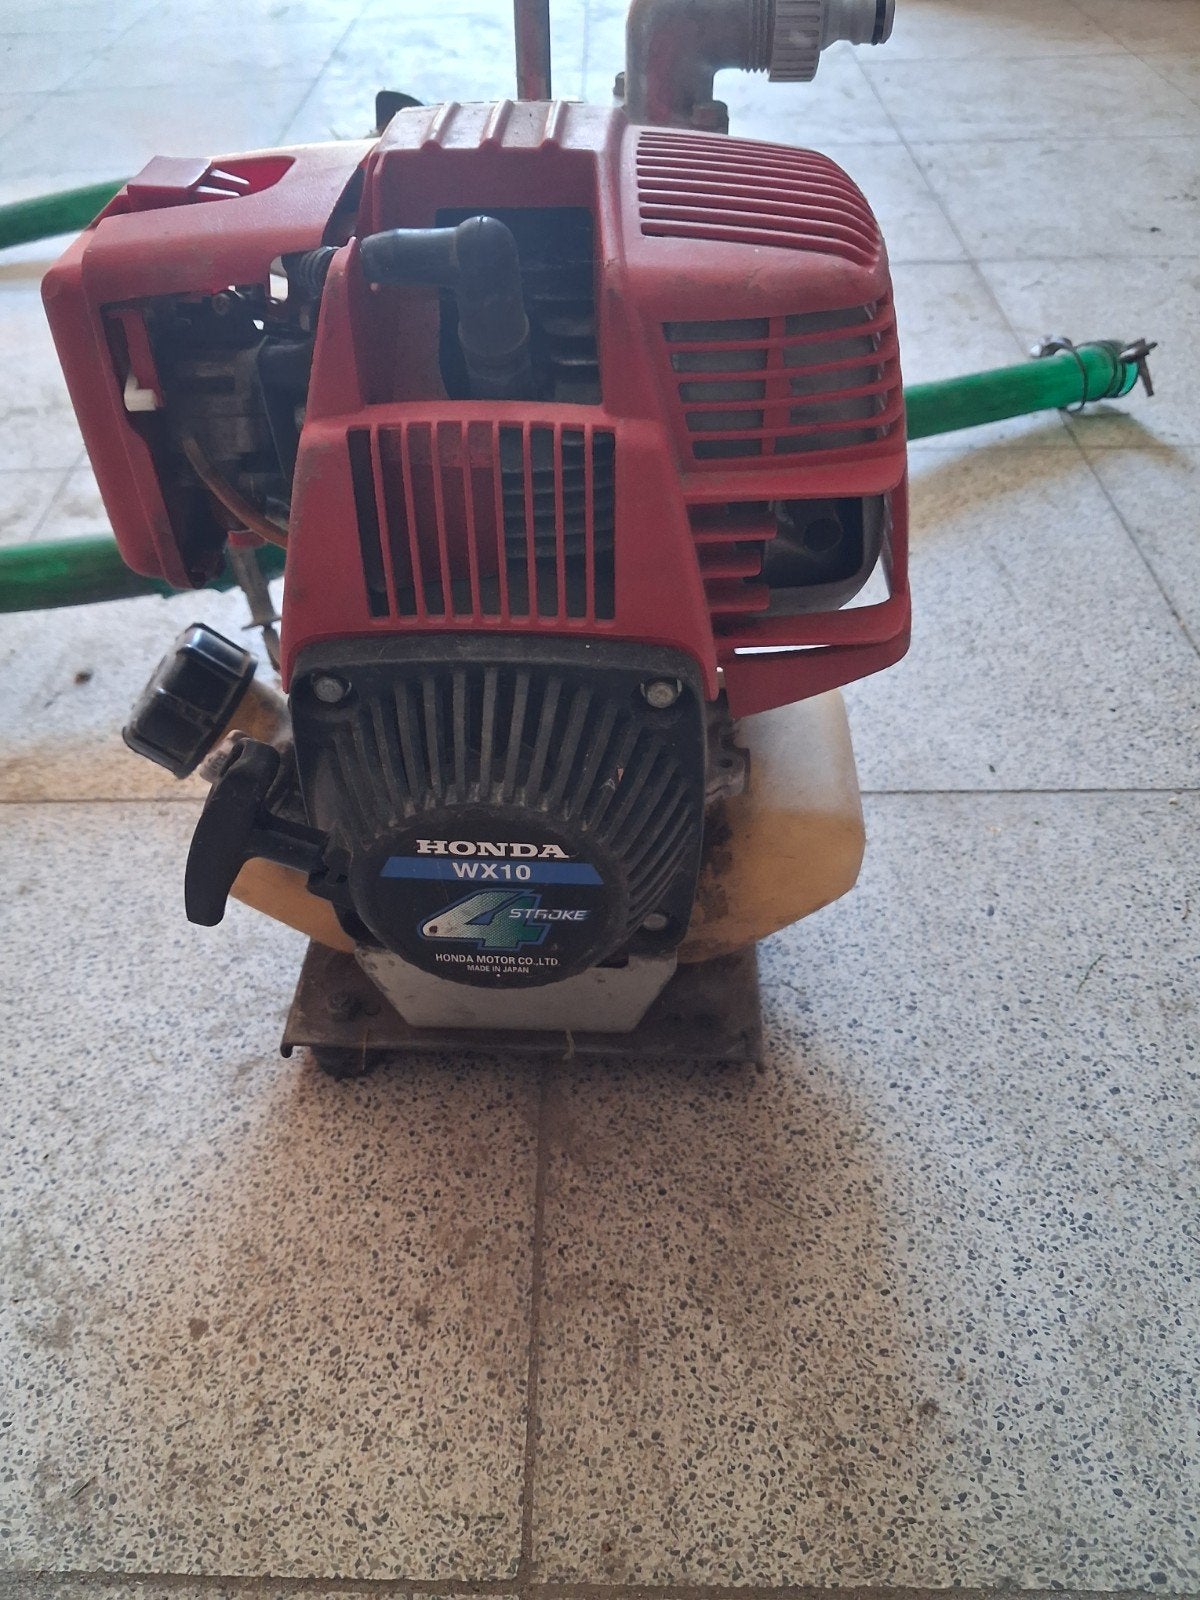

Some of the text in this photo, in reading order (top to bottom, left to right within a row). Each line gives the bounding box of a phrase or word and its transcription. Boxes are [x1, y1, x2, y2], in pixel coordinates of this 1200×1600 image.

[415, 839, 570, 859] HONDA
[452, 862, 531, 880] WX10
[417, 888, 592, 951] 4 STROKE
[435, 953, 474, 964] HONDA
[476, 955, 516, 965] MOTOR
[466, 964, 530, 974] MADE IN JAPAN
